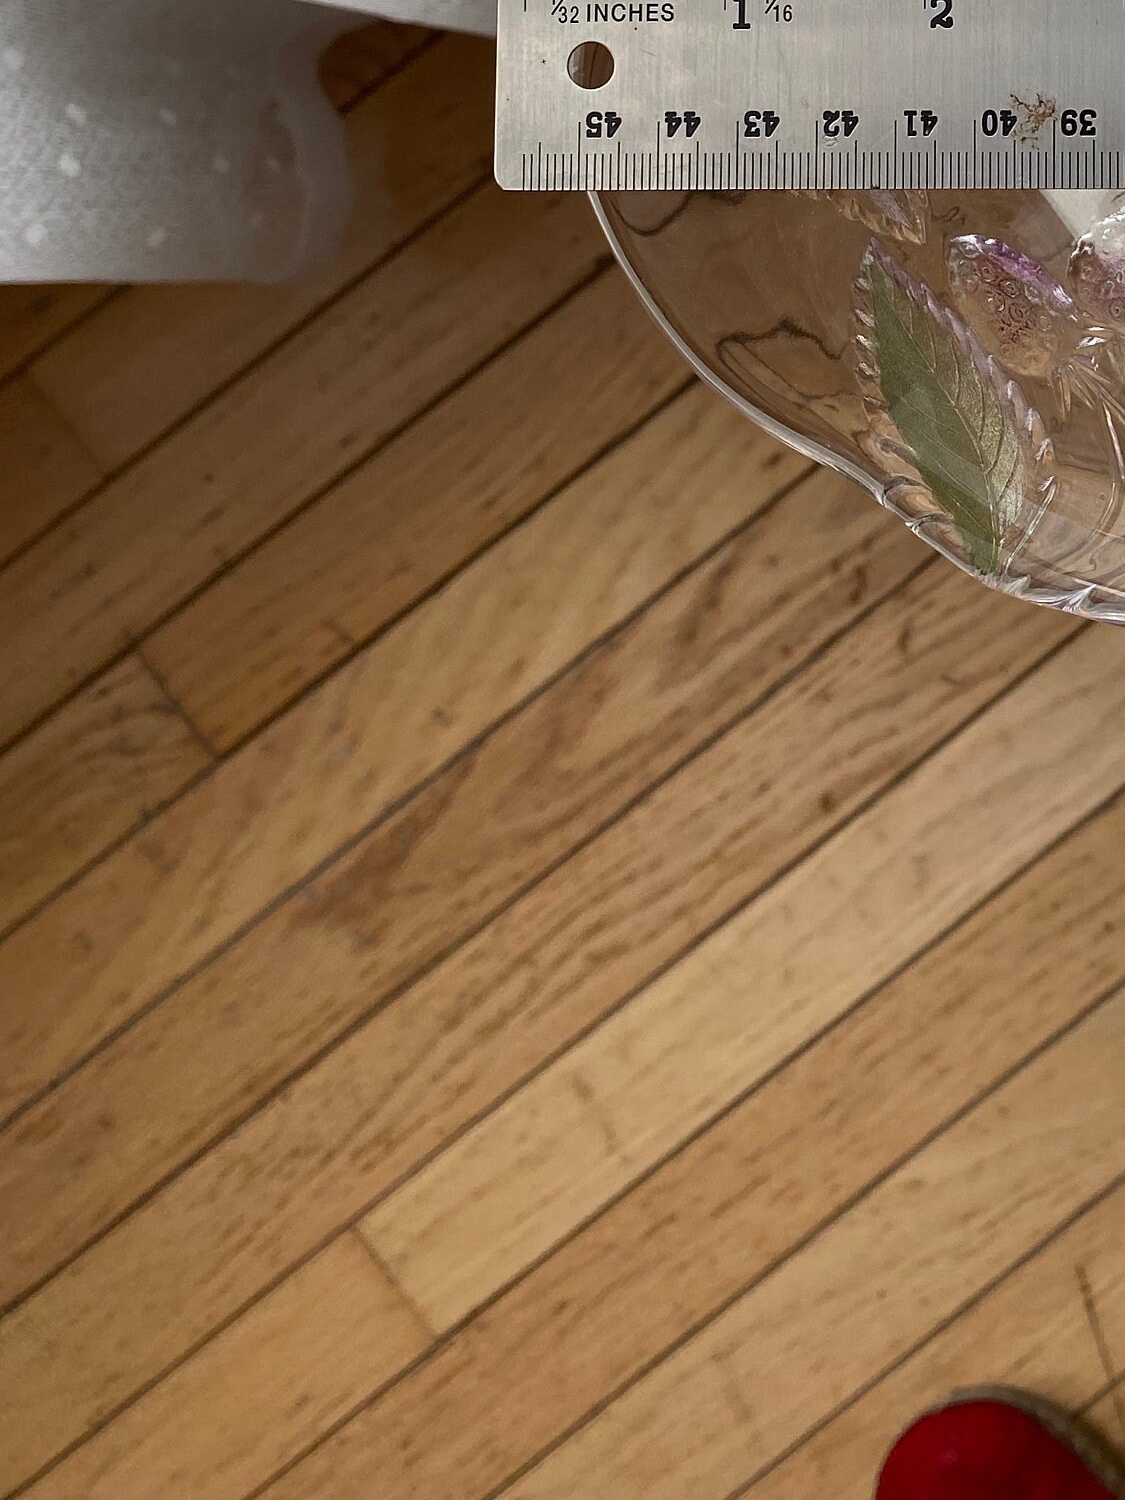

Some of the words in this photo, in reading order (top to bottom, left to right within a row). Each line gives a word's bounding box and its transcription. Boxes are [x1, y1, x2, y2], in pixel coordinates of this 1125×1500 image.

[586, 2, 675, 23] INCHES
[585, 111, 623, 139] 45
[664, 110, 702, 138] 44
[743, 110, 781, 138] 43
[822, 110, 859, 138] 42
[903, 109, 939, 137] 41
[981, 109, 1018, 137] 40
[1060, 108, 1097, 137] 39
